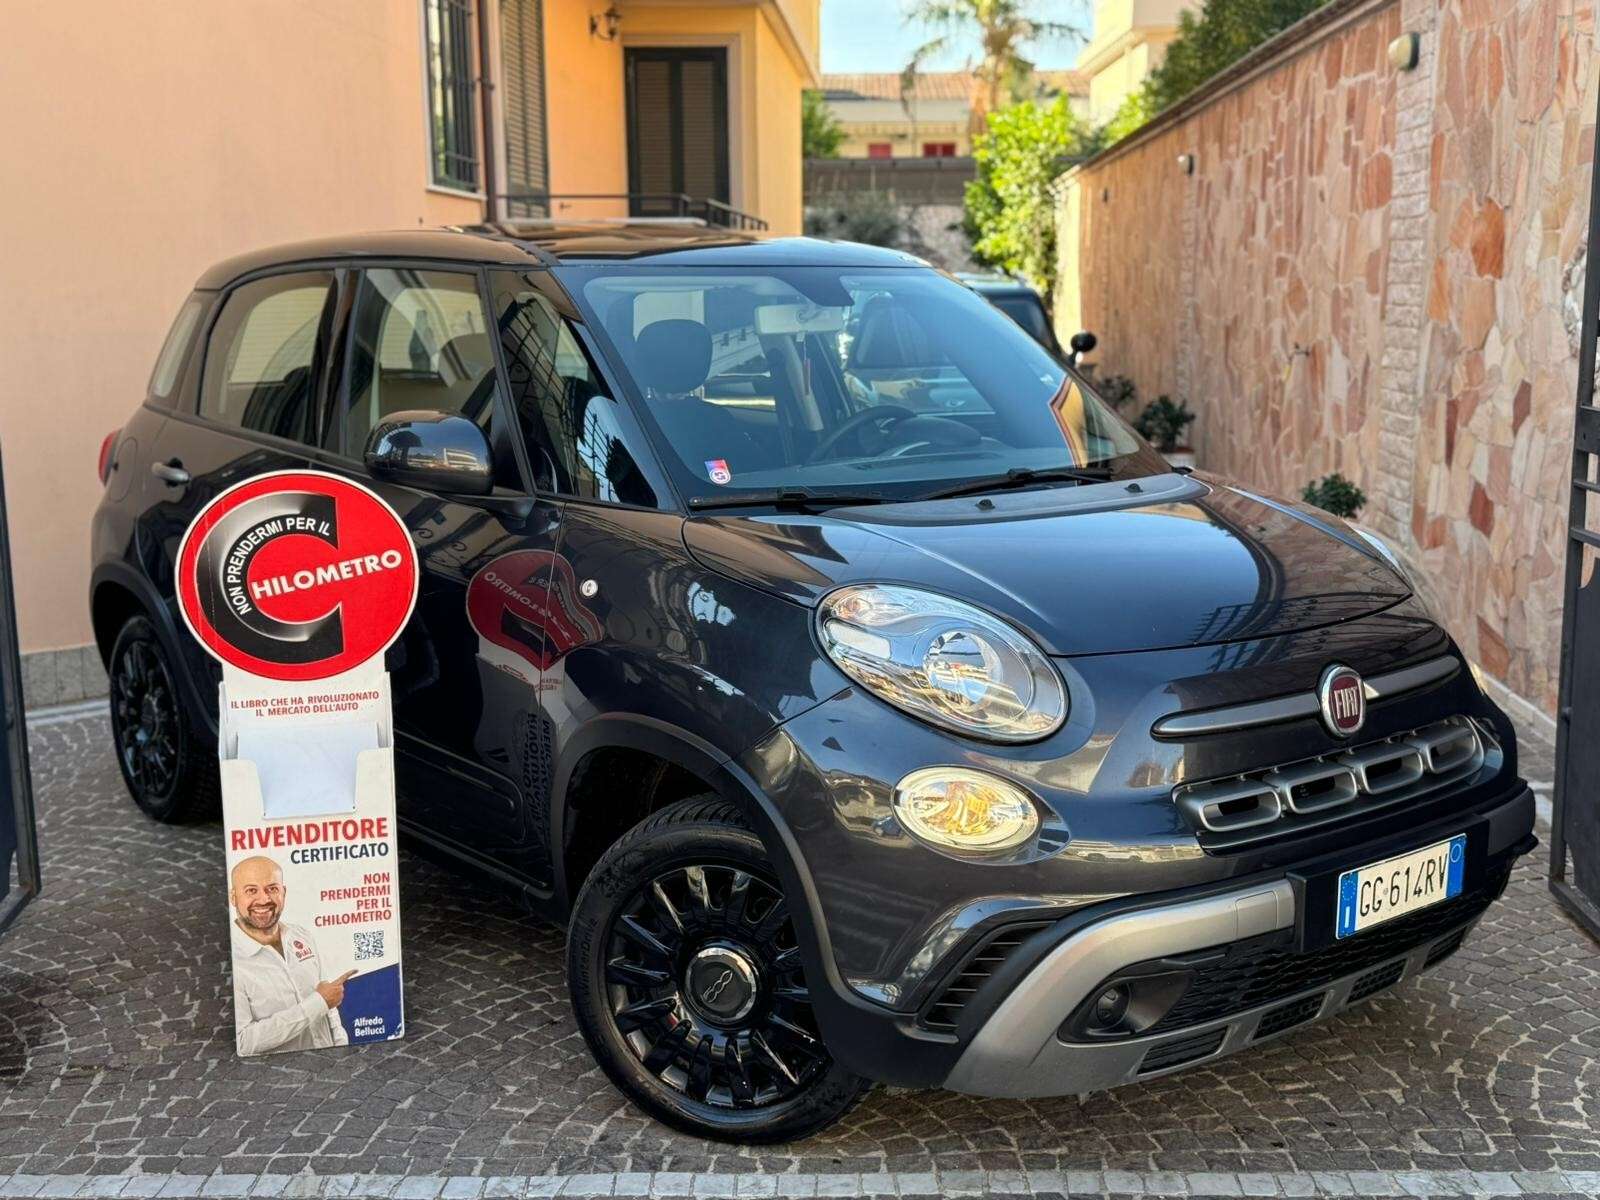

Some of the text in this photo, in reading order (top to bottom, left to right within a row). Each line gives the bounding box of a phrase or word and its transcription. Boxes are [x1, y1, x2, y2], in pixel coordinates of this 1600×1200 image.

[226, 517, 331, 616] NON PRENDERMI PER IL
[251, 549, 402, 600] HILOMETRO
[231, 691, 380, 709] IL LIBRO CHE HA RIVOLUZIONATO
[1333, 686, 1358, 720] FIAT
[256, 702, 359, 717] IL MERCATO DELL'AUTO
[231, 817, 389, 851] RIVENDITORE
[290, 842, 390, 865] CERTIFICATO
[364, 872, 391, 885] NON
[320, 885, 391, 902] PRENDERMI
[357, 898, 392, 911] PER IL
[314, 910, 392, 928] CHILOMETRO
[354, 1016, 384, 1029] Alfredo
[355, 1026, 386, 1039] Bellucci
